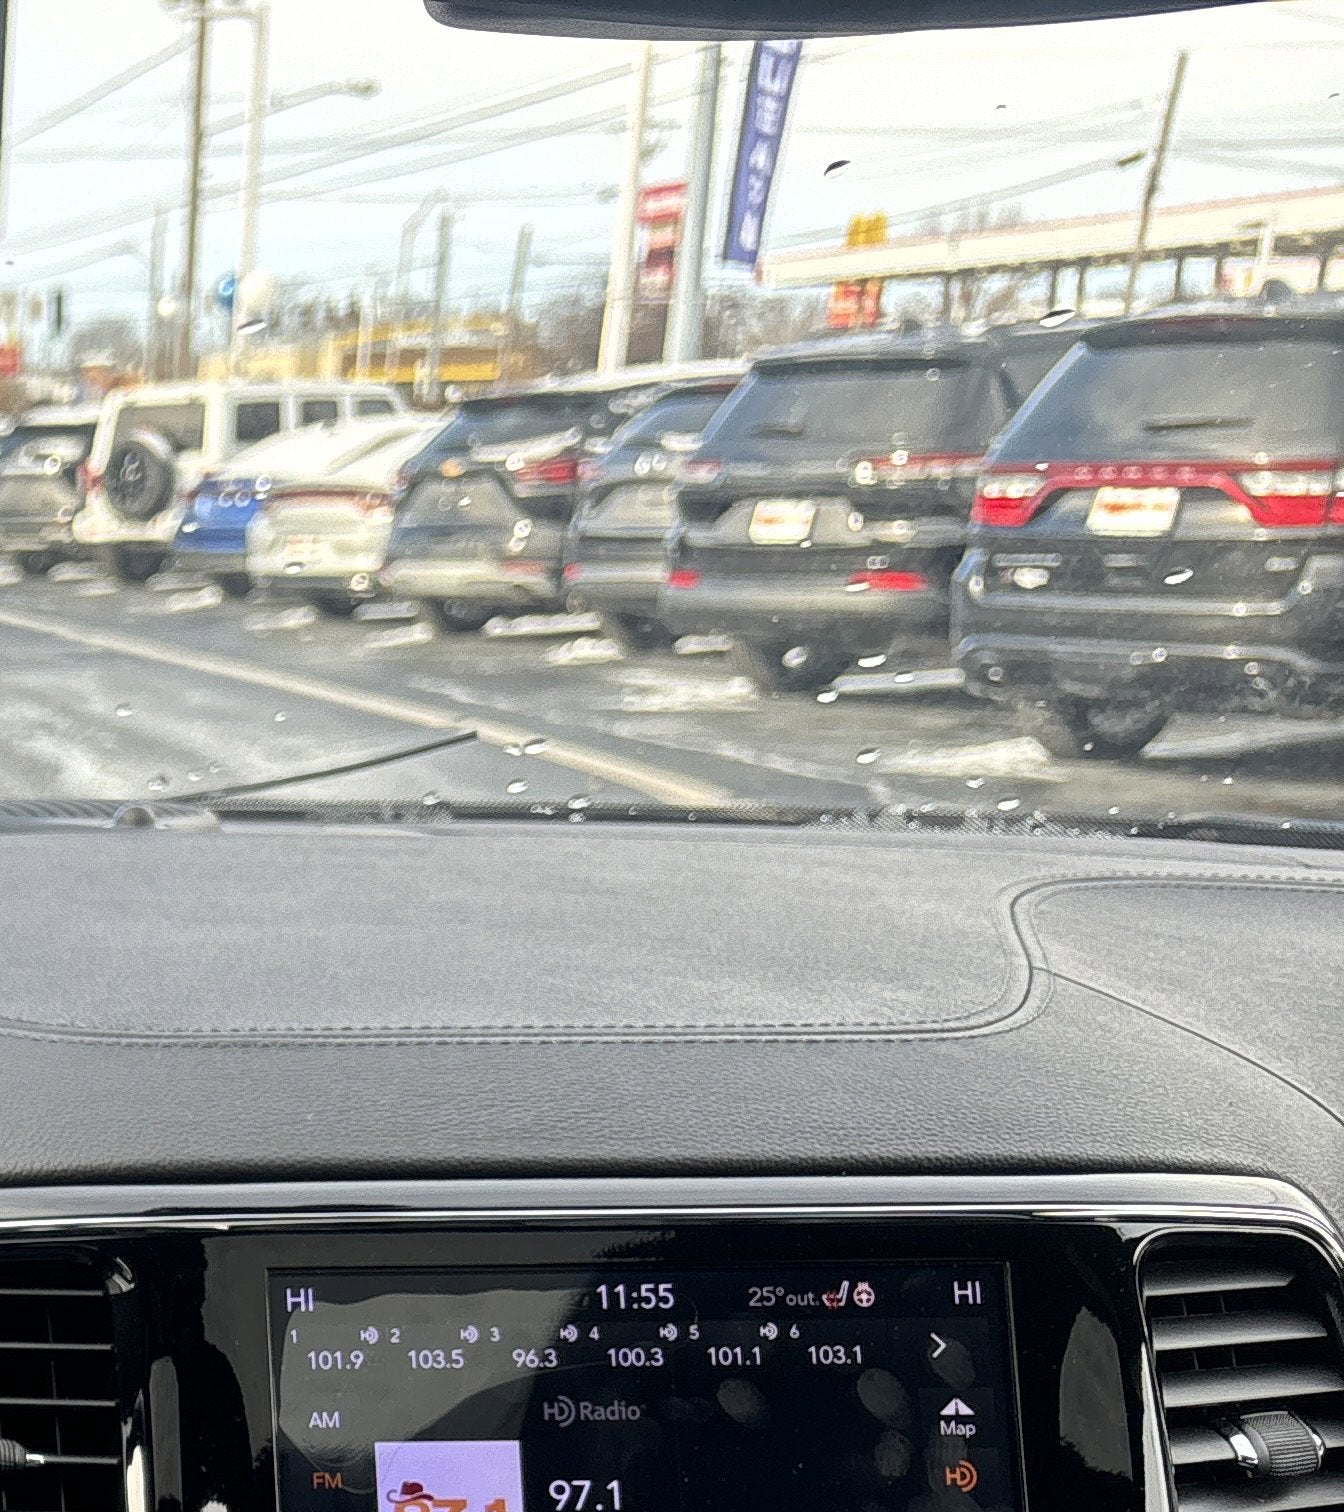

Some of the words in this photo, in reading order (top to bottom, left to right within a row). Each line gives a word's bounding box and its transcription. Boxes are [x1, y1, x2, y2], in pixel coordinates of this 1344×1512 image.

[286, 1288, 313, 1312] HI
[596, 1283, 674, 1310] 11:55
[953, 1281, 981, 1304] HI
[290, 1330, 297, 1344] 1
[390, 1329, 400, 1343] 2
[490, 1327, 501, 1342] 3
[588, 1326, 600, 1340] 4
[689, 1325, 700, 1340] 5
[789, 1324, 800, 1339] 6
[308, 1351, 364, 1370] 101.9
[408, 1350, 464, 1369] 103.5
[513, 1349, 558, 1368] 96.3
[607, 1348, 663, 1367] 100.3
[708, 1347, 761, 1366] 101.1
[808, 1346, 862, 1365] 103.1
[309, 1412, 340, 1429] AM
[579, 1400, 641, 1421] Radio
[939, 1420, 976, 1438] Map
[313, 1473, 342, 1489] FM
[548, 1480, 621, 1511] 97.1
